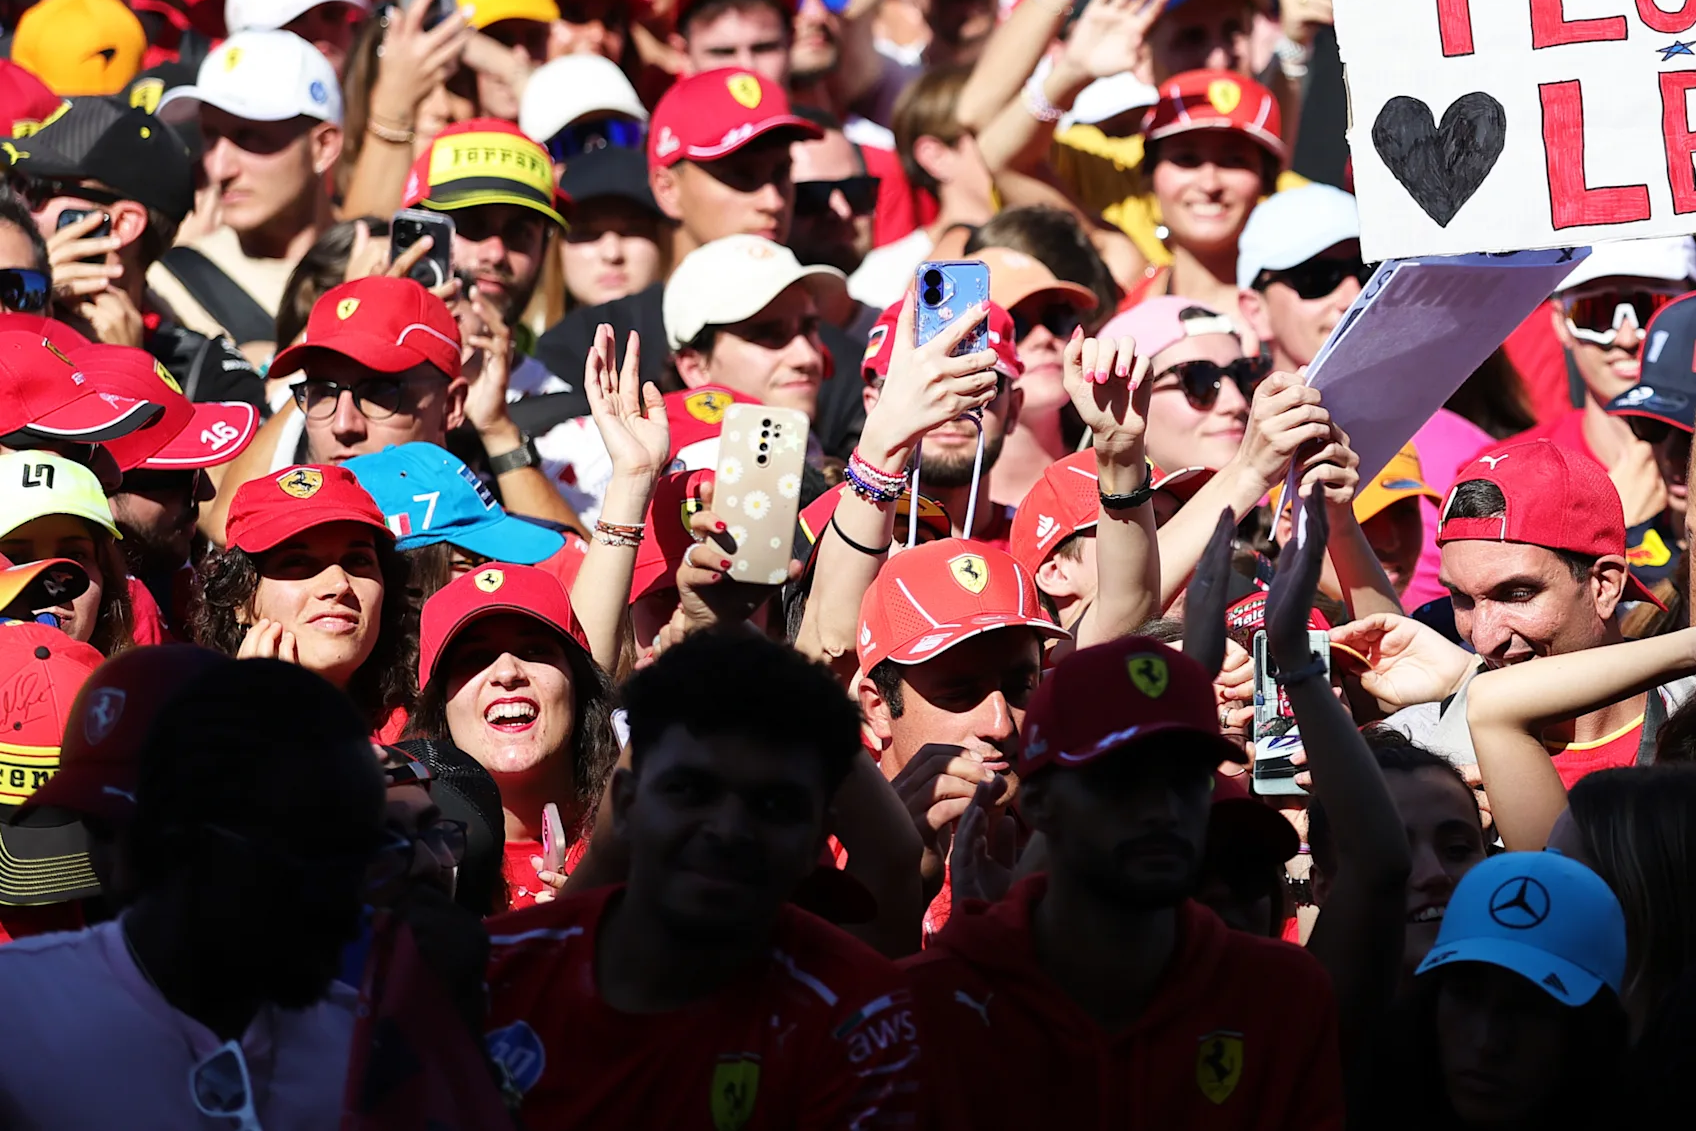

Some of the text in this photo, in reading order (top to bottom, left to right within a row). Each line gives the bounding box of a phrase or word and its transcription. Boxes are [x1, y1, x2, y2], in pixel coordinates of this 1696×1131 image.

[200, 421, 240, 451] 16
[412, 491, 441, 530] 7
[848, 1009, 917, 1065] aws
